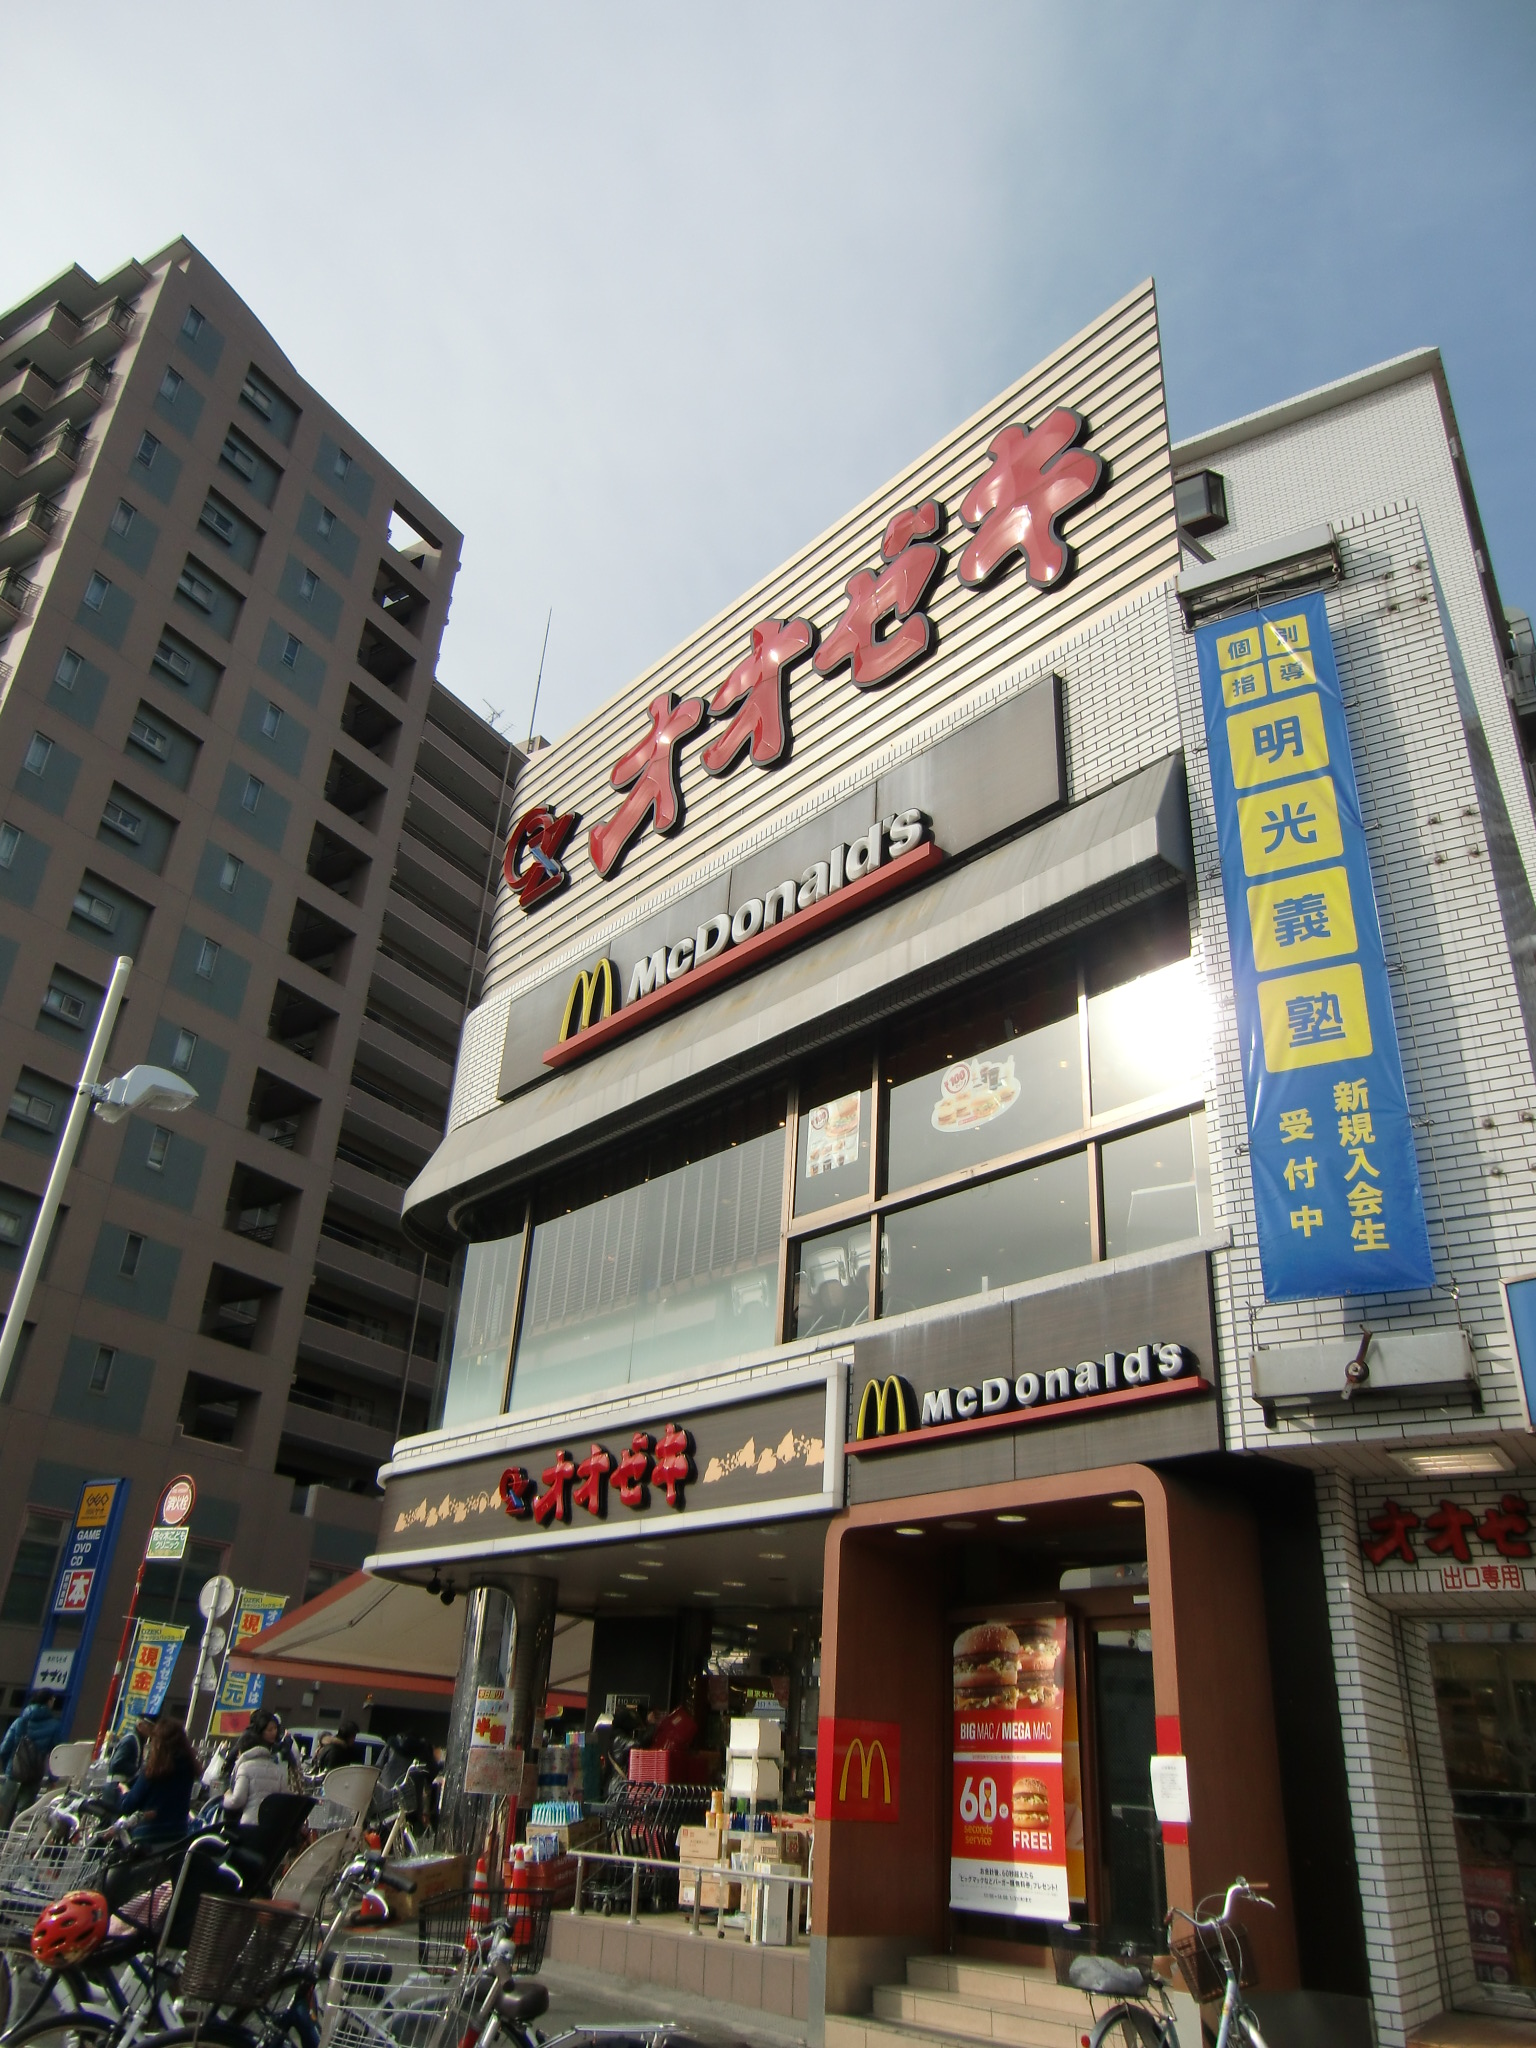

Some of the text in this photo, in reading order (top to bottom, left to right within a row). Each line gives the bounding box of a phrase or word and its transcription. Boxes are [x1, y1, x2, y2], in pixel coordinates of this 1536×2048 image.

[588, 406, 1106, 879] オオゼキ
[1252, 713, 1346, 1047] 明光義塾
[626, 807, 930, 1006] McDonald's
[1279, 1108, 1323, 1237] 受付中
[1333, 1078, 1390, 1252] 新規入会生
[922, 1343, 1183, 1425] McDonald's
[533, 1422, 689, 1525] オオゼキ
[165, 1495, 189, 1512] 消火栓
[73, 1542, 92, 1554] DVD
[77, 1529, 102, 1541] GAME
[70, 1555, 84, 1567] CD
[68, 1575, 90, 1605] 本
[1443, 1564, 1521, 1590] 出口専用
[960, 1723, 976, 1740] BIG
[977, 1723, 994, 1740] MAC
[1001, 1722, 1031, 1740] MEGA
[1033, 1722, 1052, 1740] MAC
[960, 1776, 997, 1823] 60
[964, 1825, 993, 1835] seconds
[965, 1835, 992, 1846] service
[1012, 1830, 1053, 1851] FREE!
